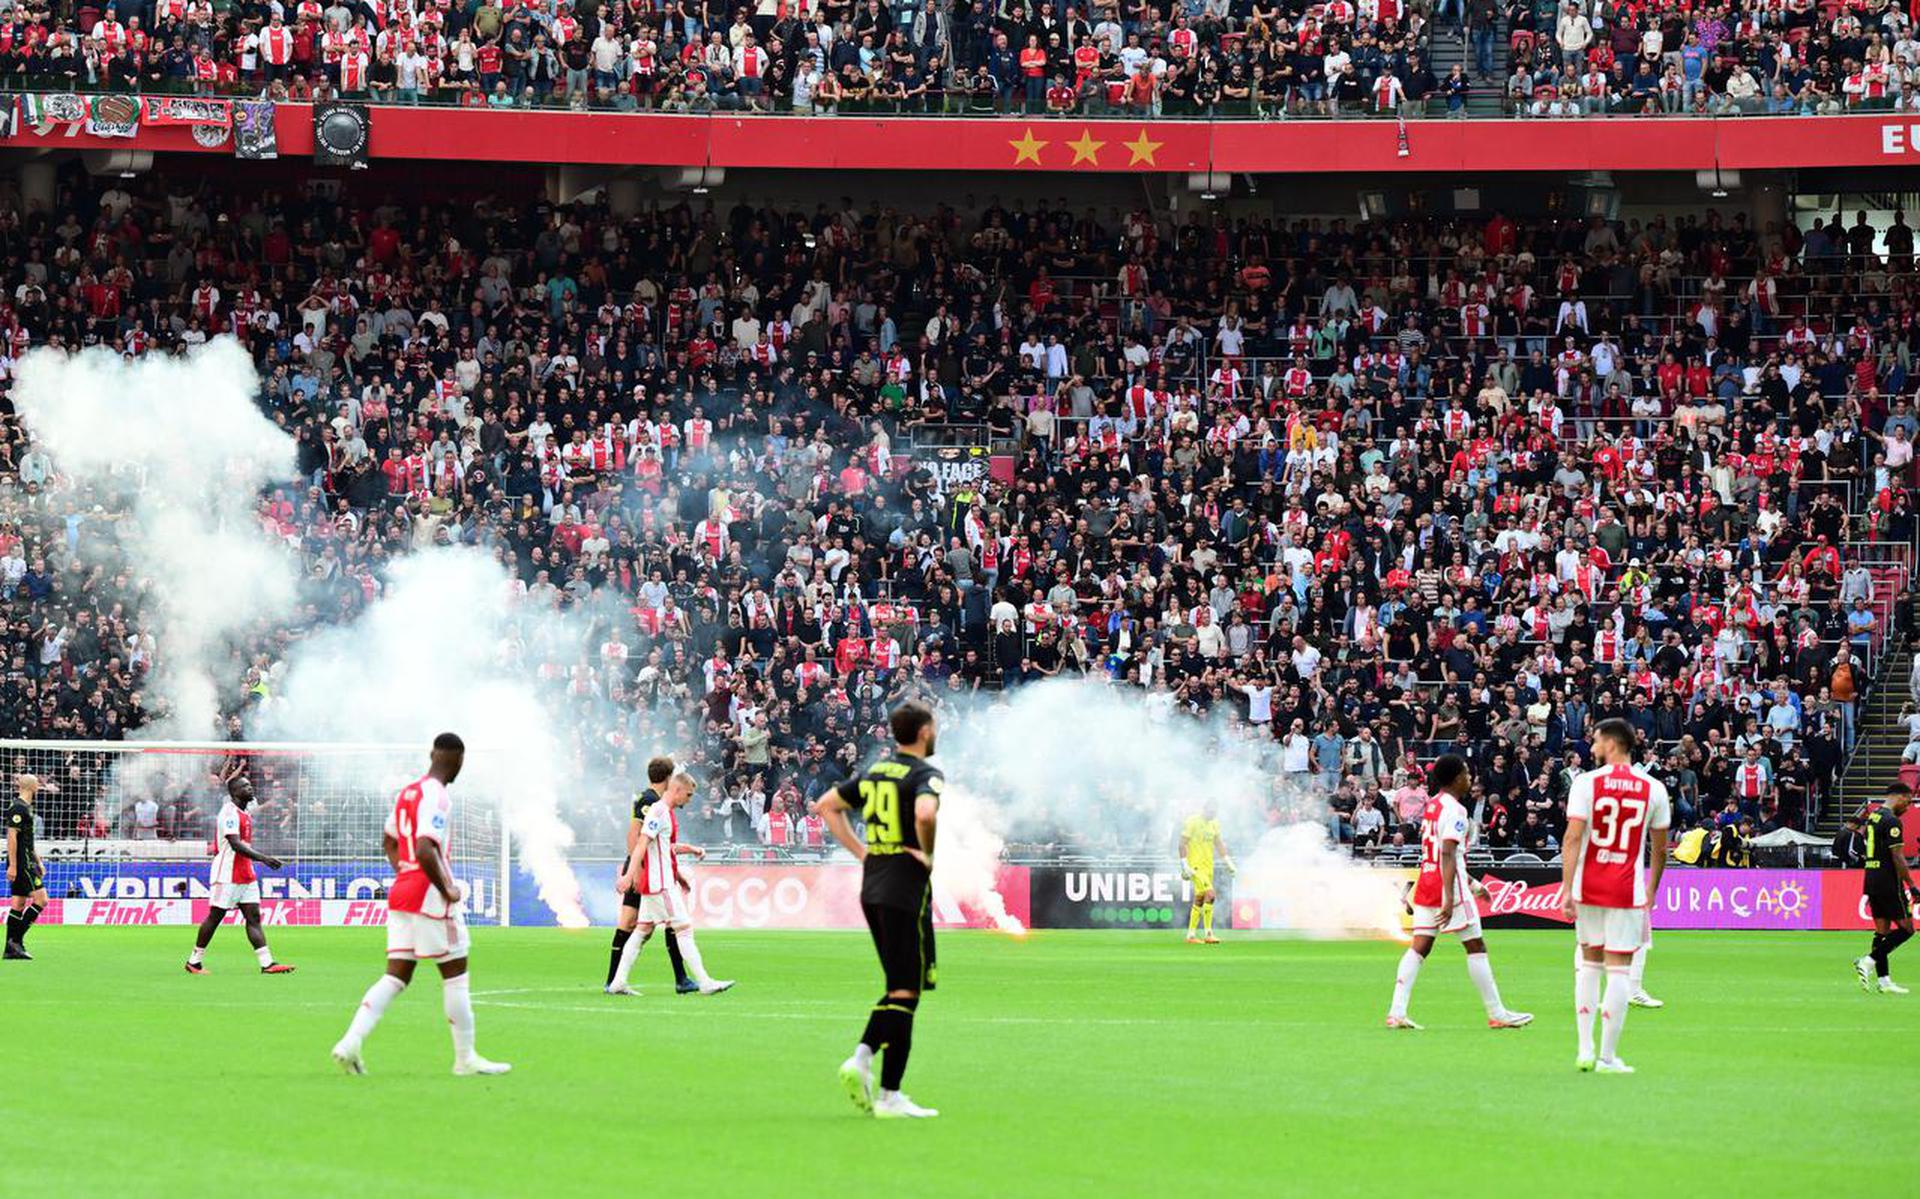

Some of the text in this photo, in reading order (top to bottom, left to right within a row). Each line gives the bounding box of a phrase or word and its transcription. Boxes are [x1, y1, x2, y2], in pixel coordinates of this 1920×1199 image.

[942, 461, 981, 481] FACE
[858, 779, 903, 843] 29
[1591, 796, 1647, 851] 37
[1065, 872, 1191, 902] UNIBET
[1484, 880, 1565, 913] Bud
[1651, 886, 1802, 918] URAÇAO
[85, 901, 164, 925] Flink
